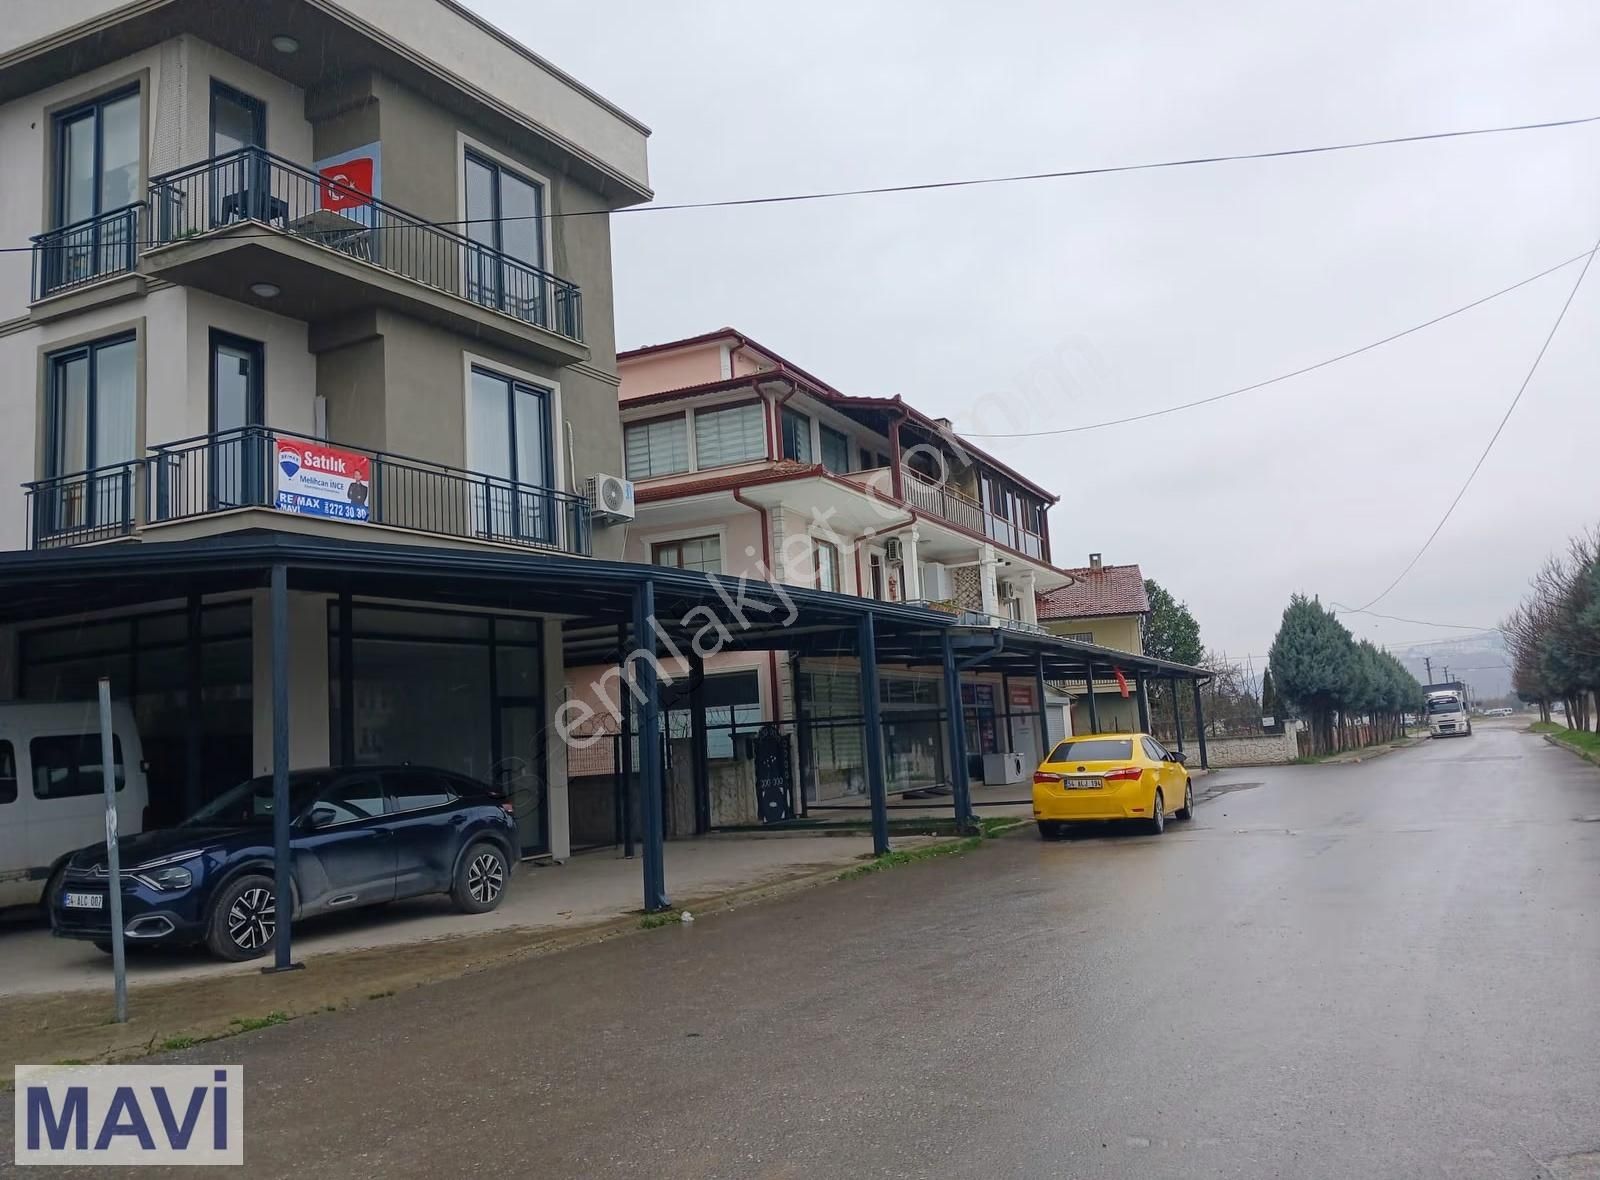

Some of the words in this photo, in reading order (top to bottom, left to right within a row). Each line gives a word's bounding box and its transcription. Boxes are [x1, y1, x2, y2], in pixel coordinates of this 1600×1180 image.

[303, 451, 346, 474] Satılık
[329, 503, 343, 516] 272
[345, 505, 355, 518] 30
[356, 507, 367, 520] 30
[91, 896, 102, 907] 007
